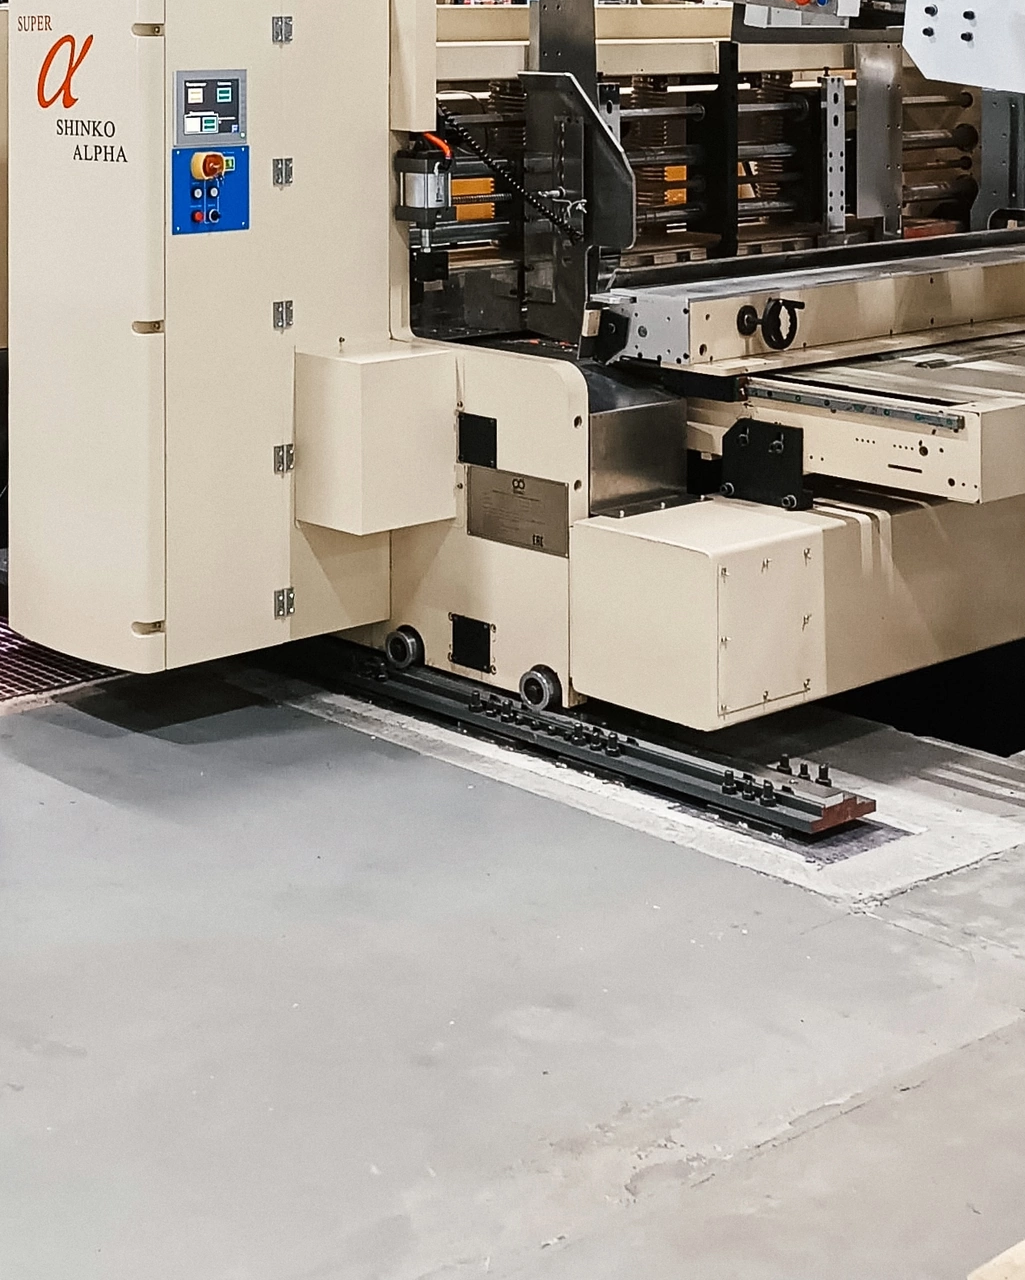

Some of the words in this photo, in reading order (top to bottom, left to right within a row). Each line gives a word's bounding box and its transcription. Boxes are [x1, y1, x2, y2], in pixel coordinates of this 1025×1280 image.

[17, 15, 53, 32] SUPER
[56, 119, 116, 138] SHINKO
[72, 144, 128, 163] ALPHA
